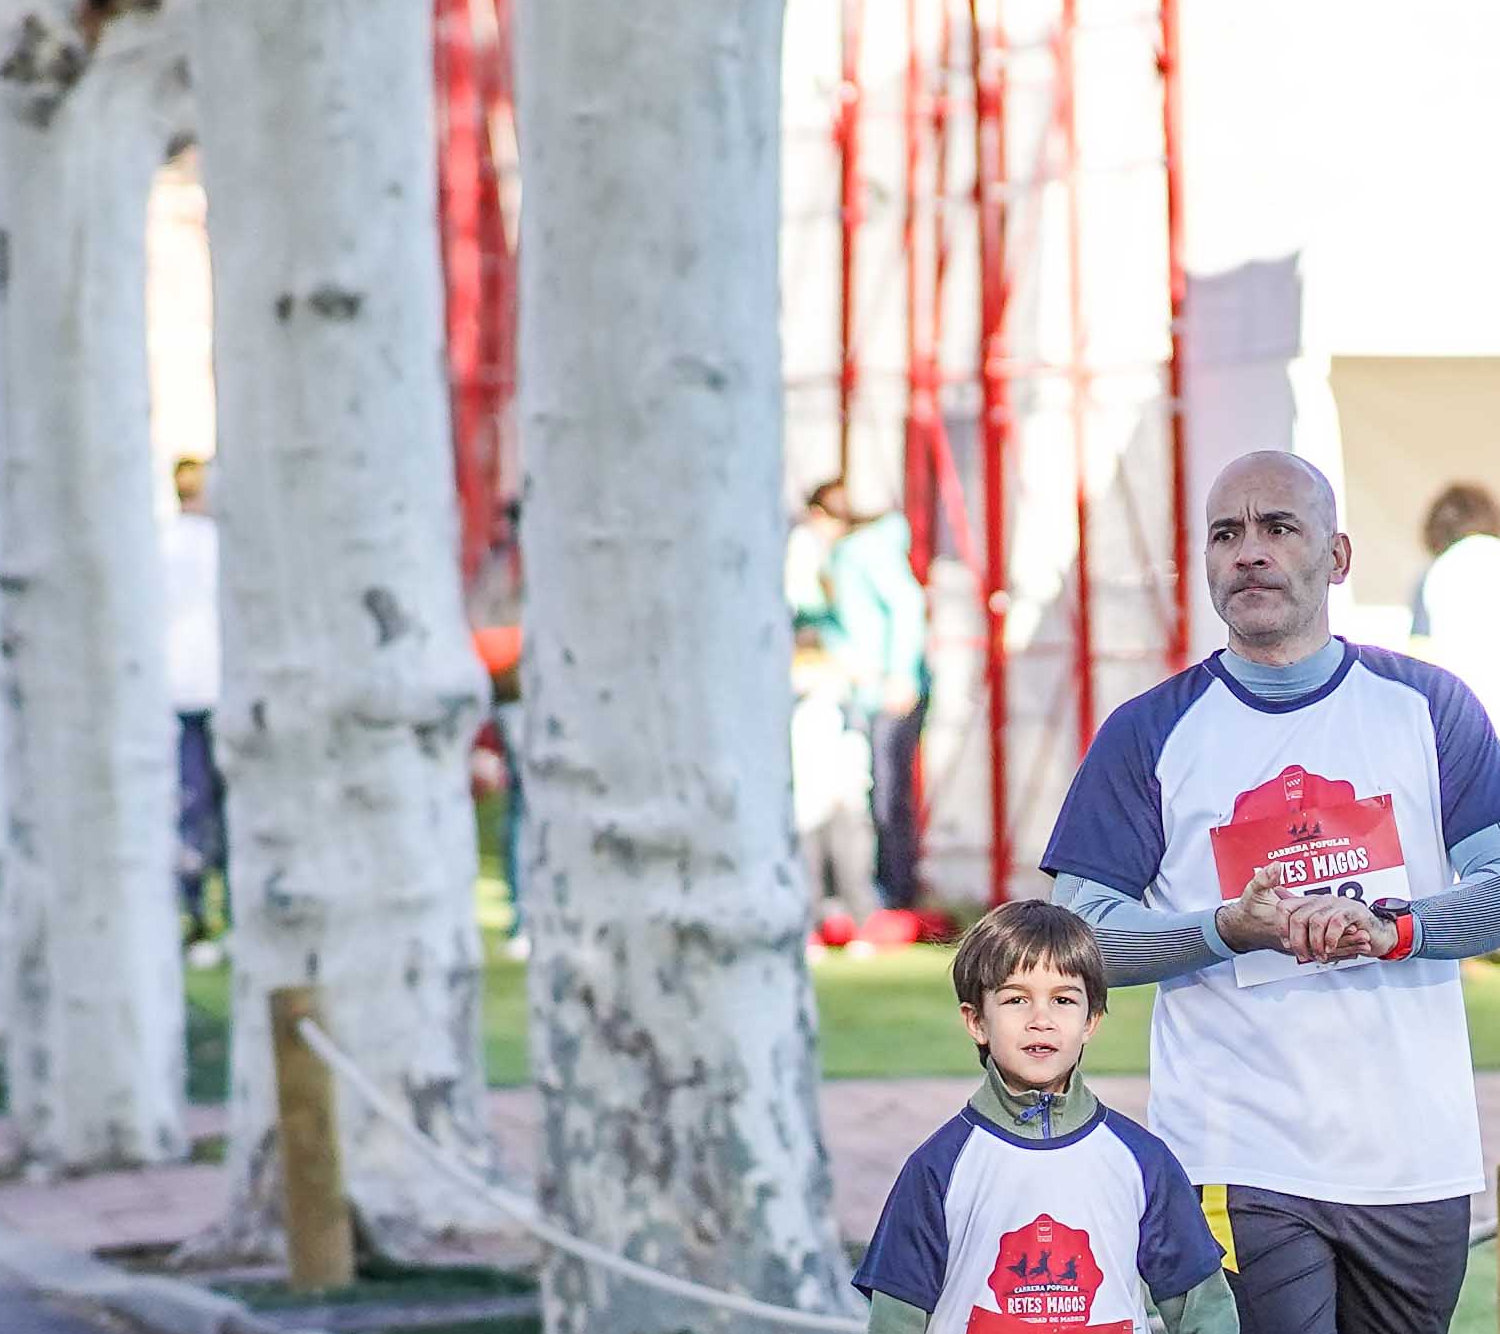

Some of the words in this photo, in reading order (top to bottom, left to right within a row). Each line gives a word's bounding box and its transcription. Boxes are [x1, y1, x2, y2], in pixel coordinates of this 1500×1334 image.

[1268, 844, 1308, 859] CARRERA
[1310, 837, 1350, 850] POPULAR
[1313, 847, 1369, 879] MAGOS
[1014, 1285, 1046, 1293] CARRERA
[1047, 1284, 1079, 1292] POPULAR
[1007, 1297, 1042, 1314] REYES
[1046, 1296, 1086, 1314] MAGOS
